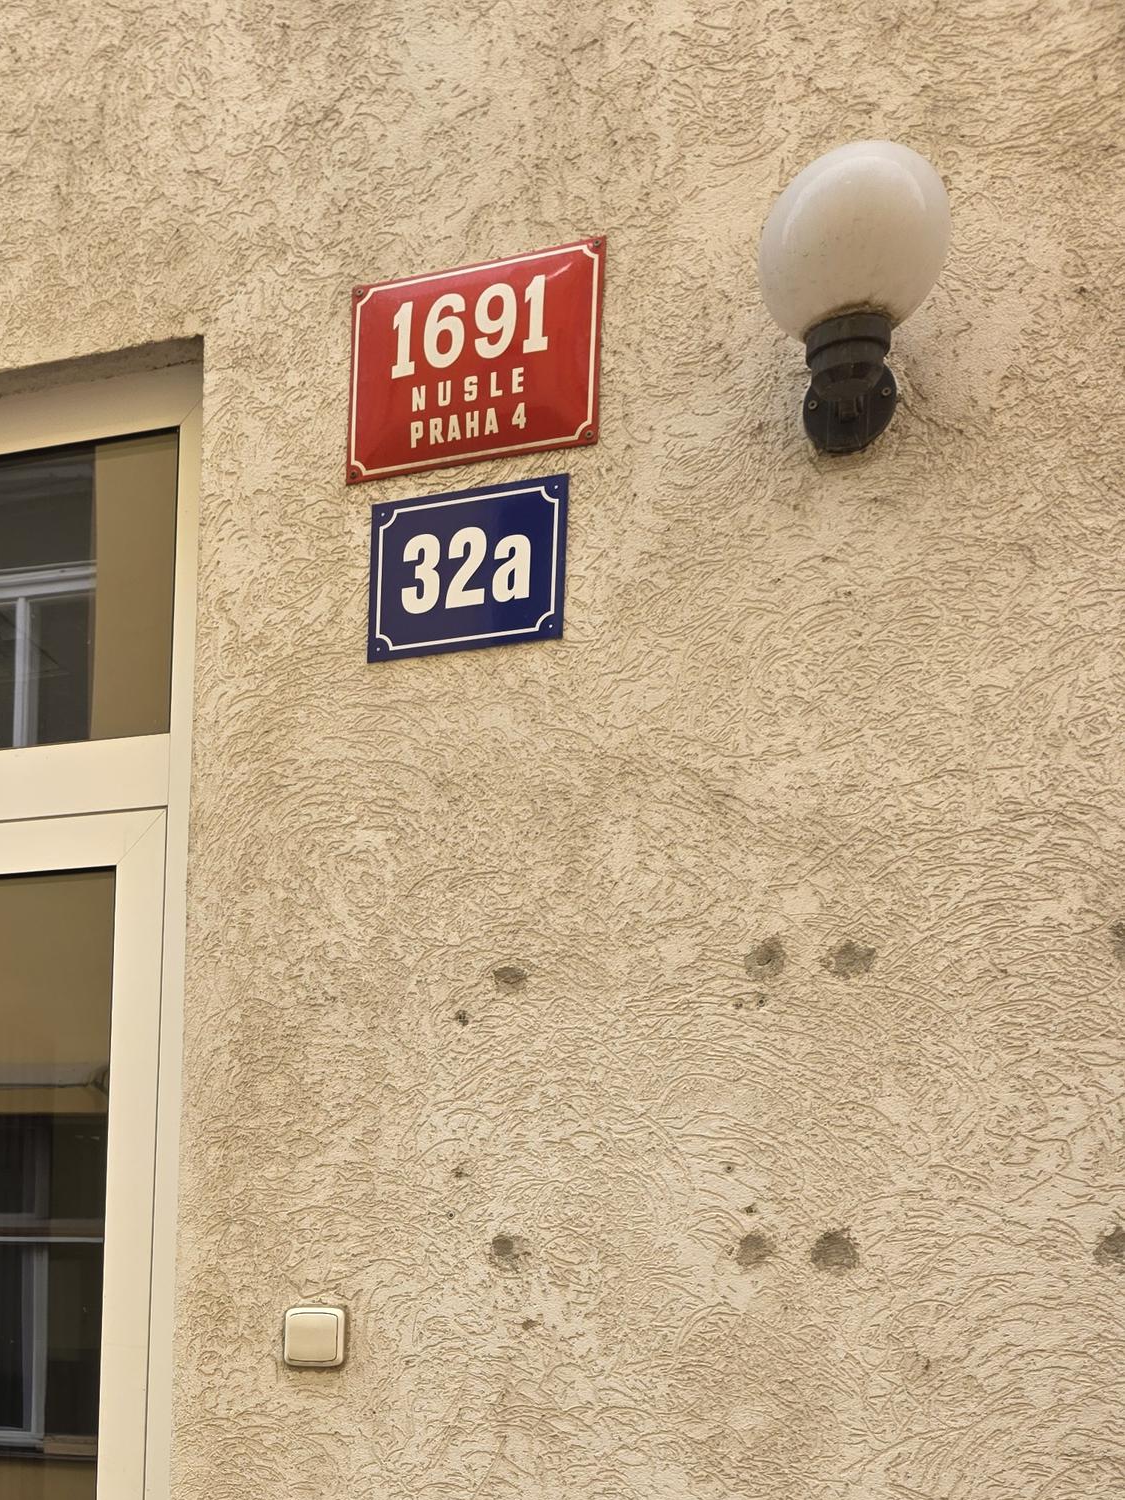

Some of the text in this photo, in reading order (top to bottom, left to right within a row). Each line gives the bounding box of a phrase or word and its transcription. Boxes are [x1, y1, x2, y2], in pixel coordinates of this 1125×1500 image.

[391, 275, 548, 379] 1691
[412, 367, 524, 412] NUSLE
[410, 402, 527, 449] PRAHA 4
[401, 526, 532, 615] 32a
